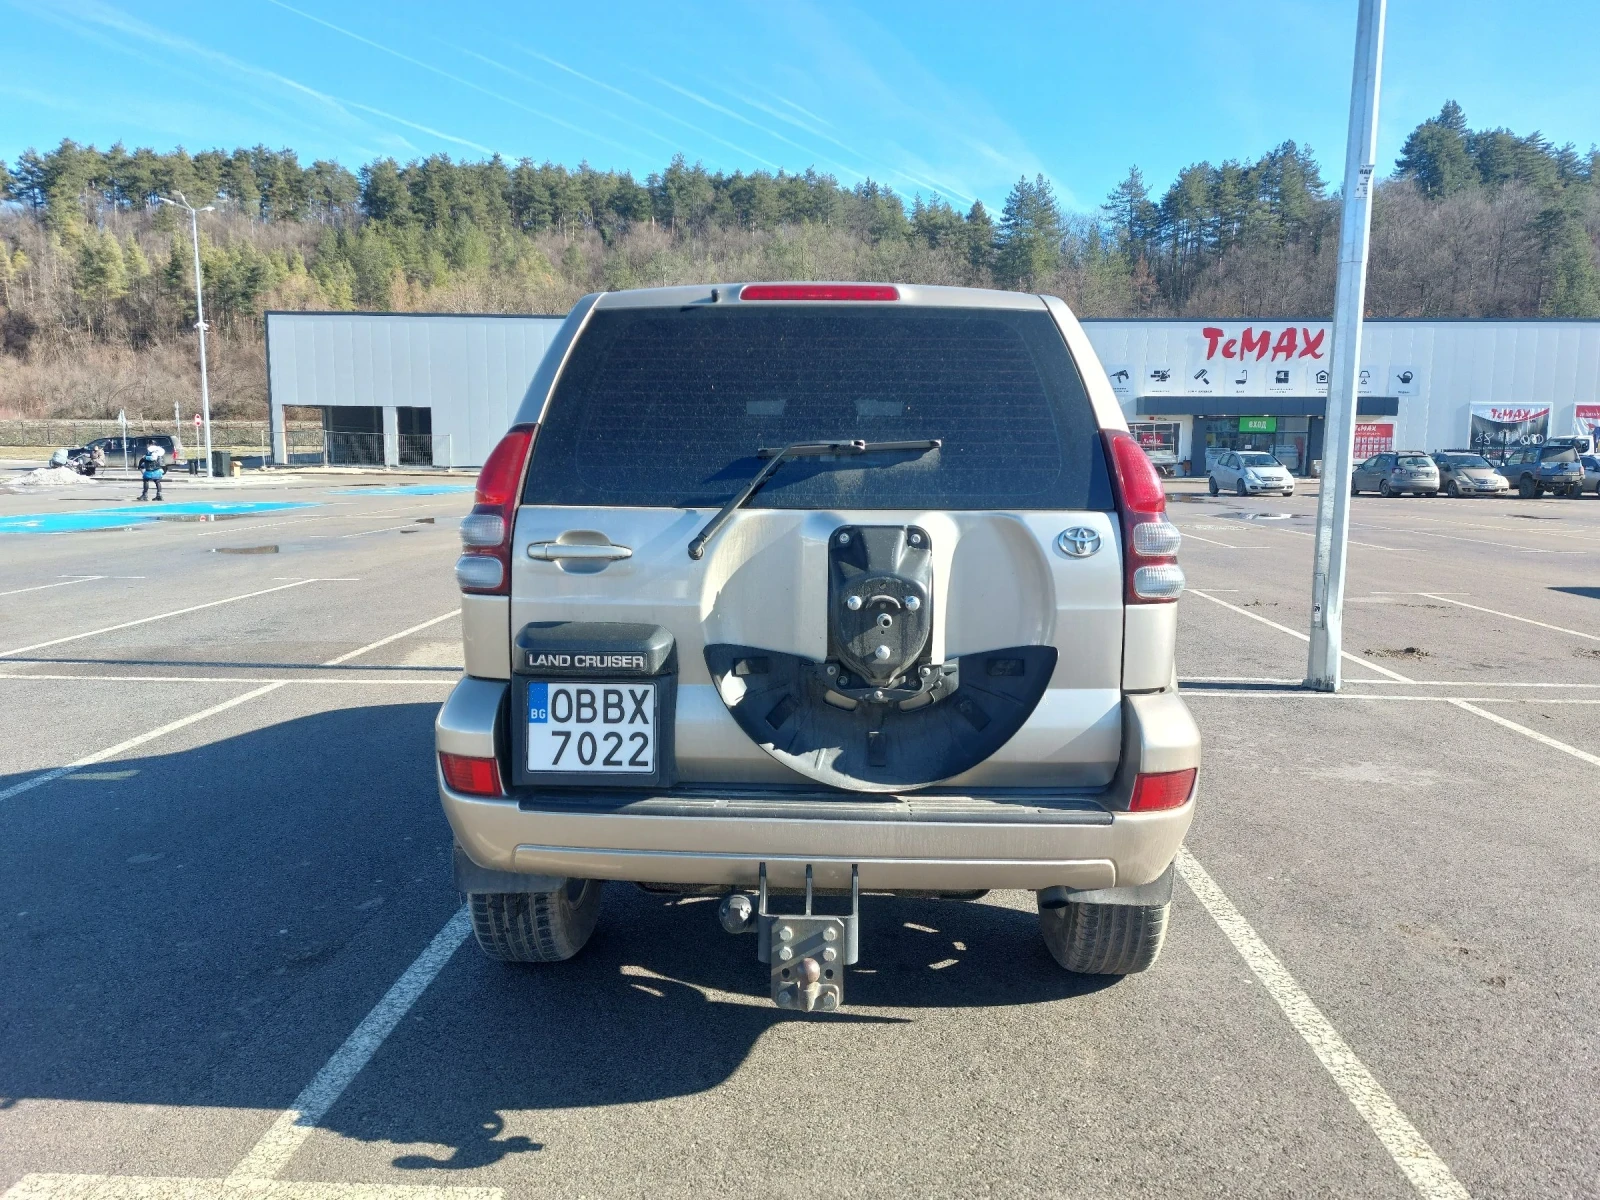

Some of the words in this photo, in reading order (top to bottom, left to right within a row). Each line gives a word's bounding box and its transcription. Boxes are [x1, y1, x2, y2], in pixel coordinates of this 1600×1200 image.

[529, 654, 570, 667] LAND
[574, 655, 644, 668] CRUISER
[530, 708, 546, 720] BG
[551, 730, 649, 767] 7022
